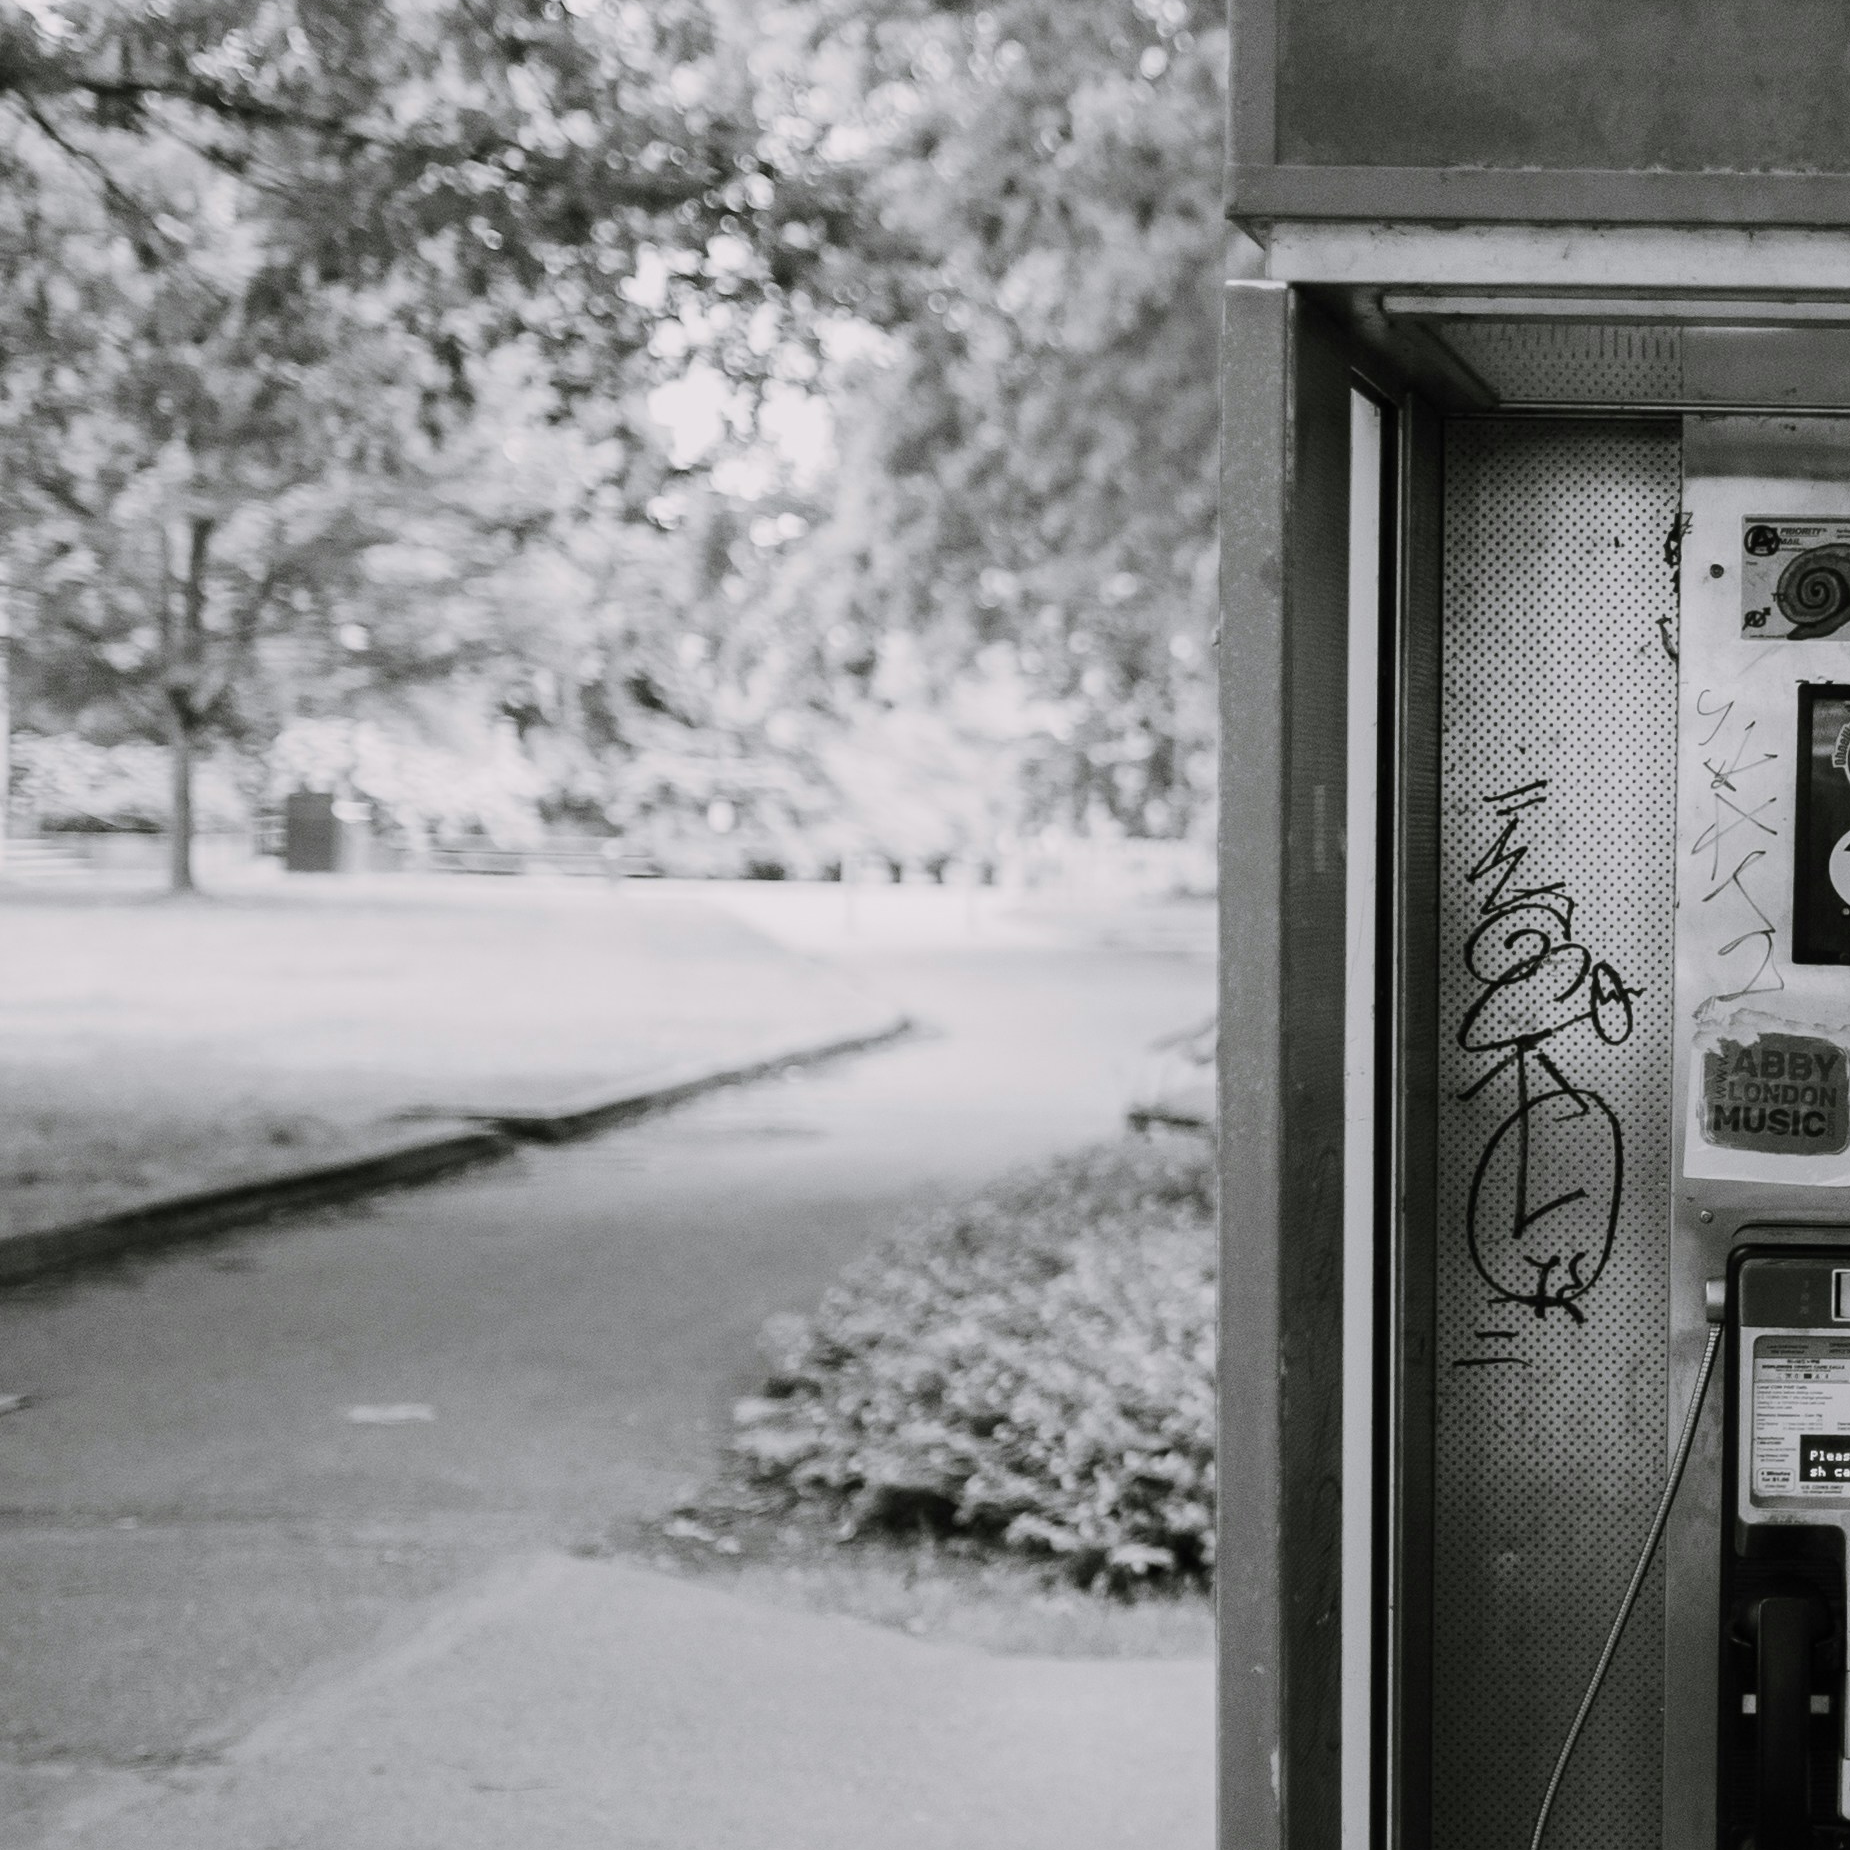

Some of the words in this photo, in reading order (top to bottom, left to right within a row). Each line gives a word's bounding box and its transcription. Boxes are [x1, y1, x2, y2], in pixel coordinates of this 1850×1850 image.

[1780, 527, 1821, 535] PRIORITY
[1731, 1049, 1839, 1082] ABBY
[1728, 1081, 1837, 1108] LONDON
[1713, 1104, 1826, 1138] MUSIC
[1809, 1466, 1827, 1478] sh
